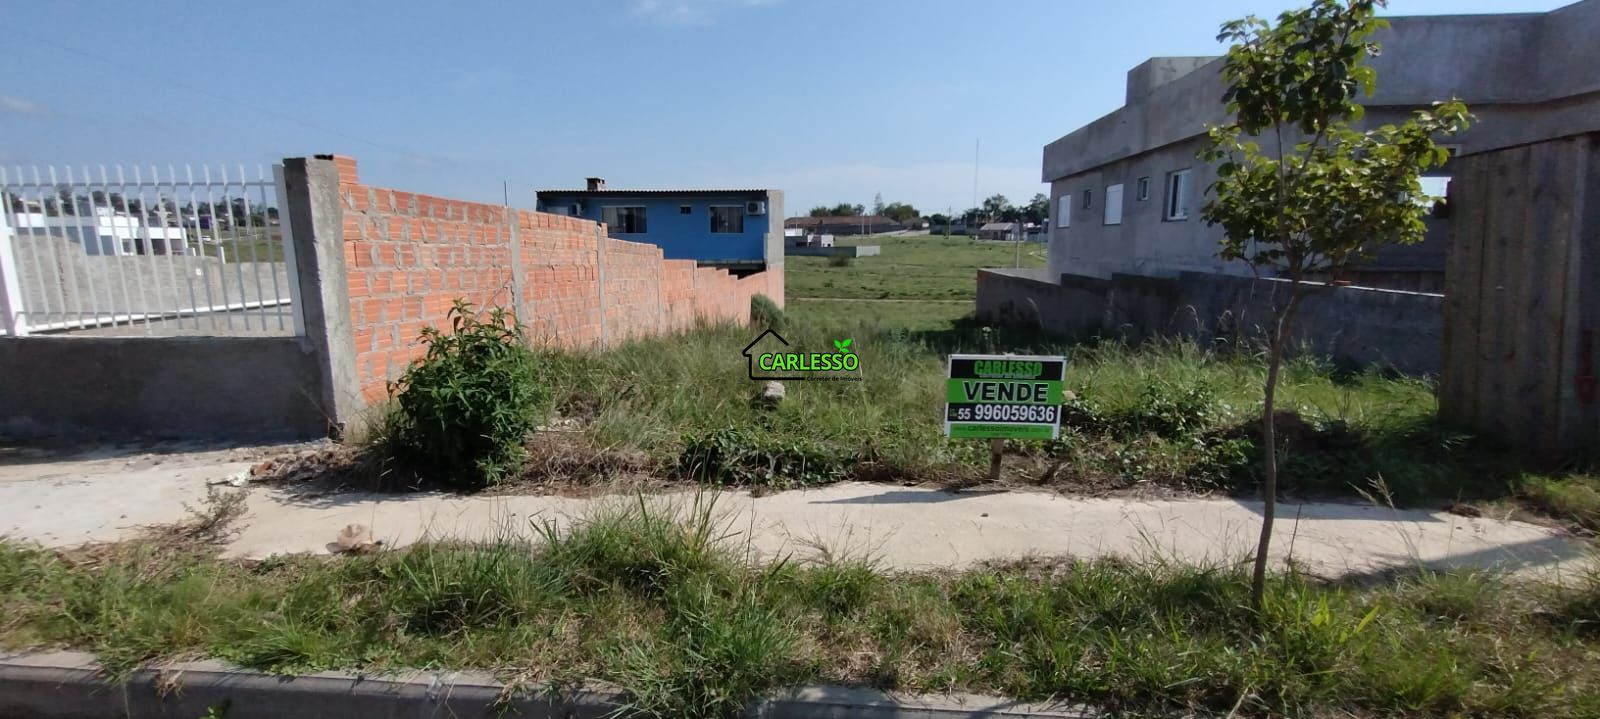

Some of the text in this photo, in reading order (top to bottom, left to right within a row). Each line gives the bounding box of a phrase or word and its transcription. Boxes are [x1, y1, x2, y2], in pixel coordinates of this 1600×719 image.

[974, 360, 1042, 376] CARLESSO
[964, 381, 1048, 402] VENDE
[958, 407, 971, 420] 55
[975, 404, 1055, 422] 996059636
